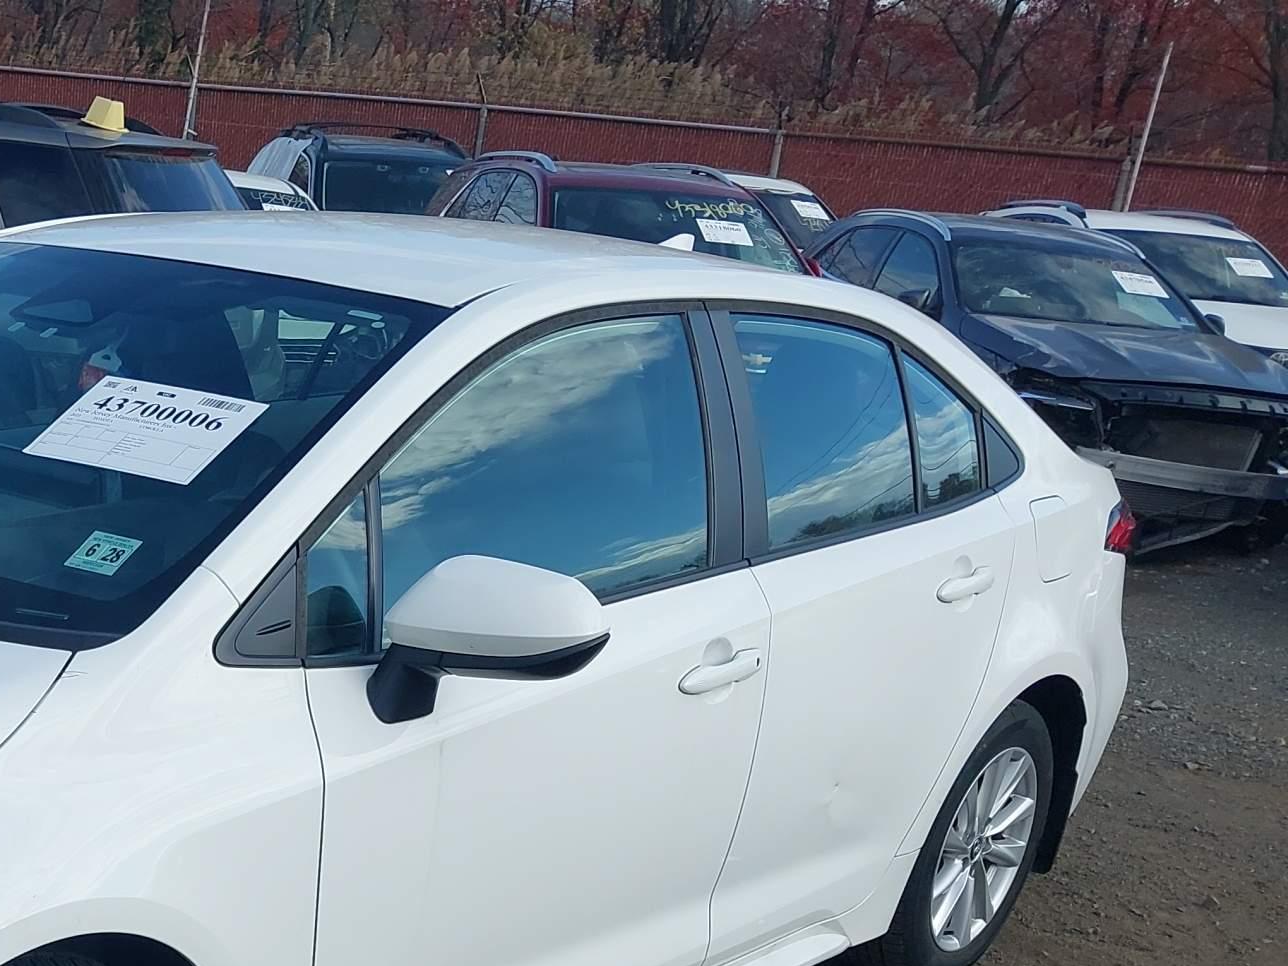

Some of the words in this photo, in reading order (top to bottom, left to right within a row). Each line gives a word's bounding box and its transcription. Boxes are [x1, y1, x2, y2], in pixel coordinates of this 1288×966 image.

[93, 396, 230, 431] 43700006
[85, 543, 101, 557] 6
[101, 547, 126, 563] 28
